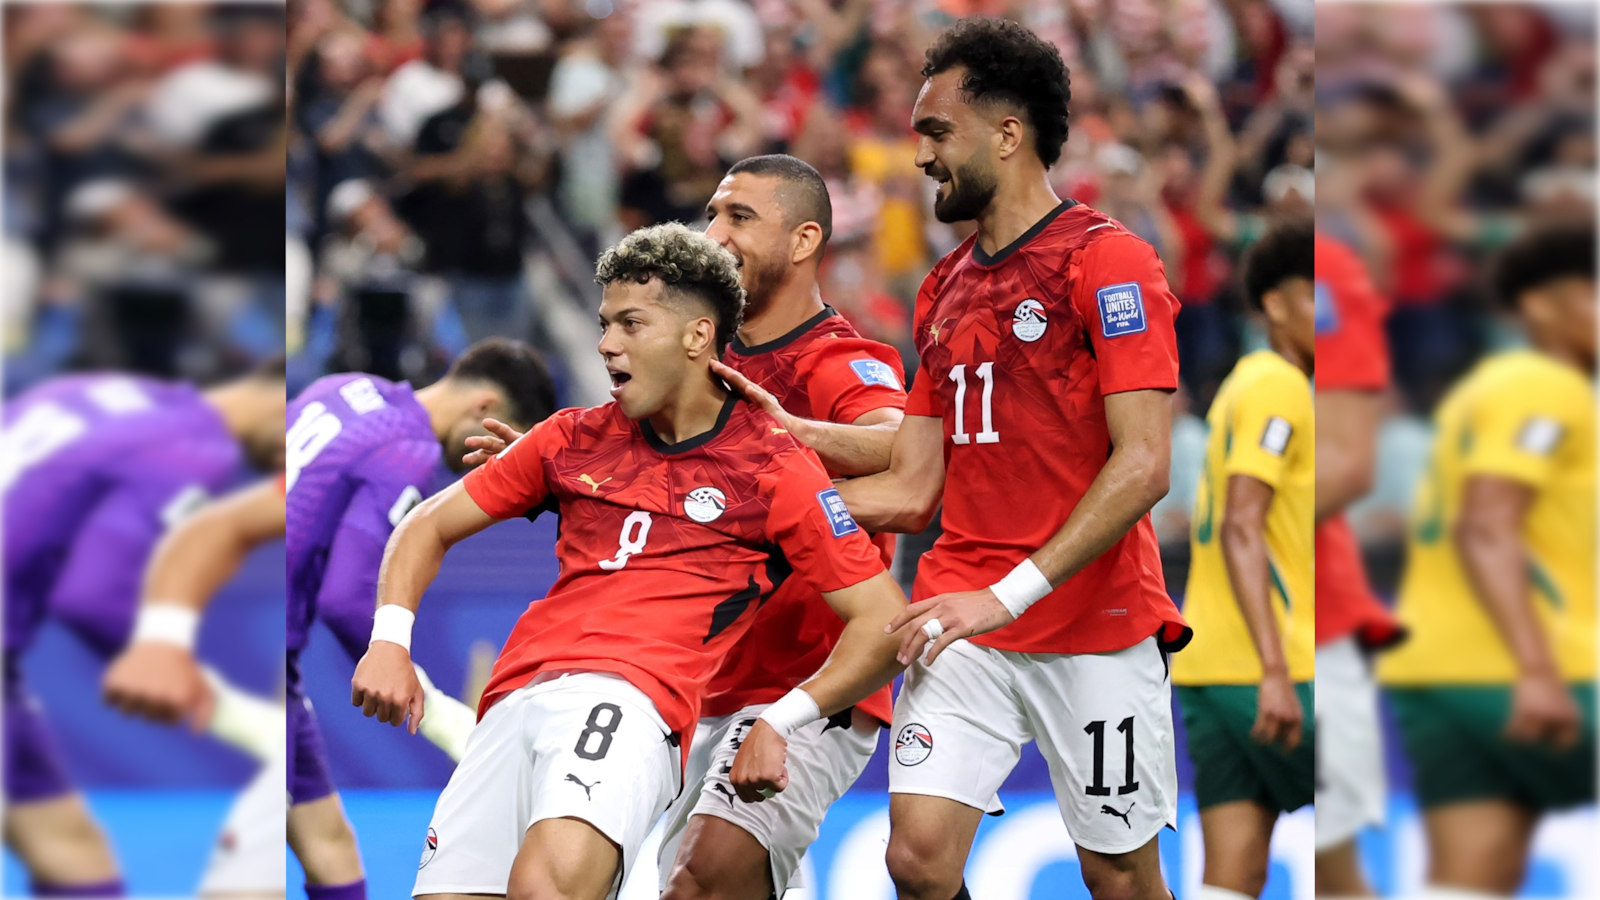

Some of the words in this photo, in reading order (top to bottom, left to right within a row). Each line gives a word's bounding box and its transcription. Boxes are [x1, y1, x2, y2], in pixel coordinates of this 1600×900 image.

[1103, 291, 1134, 303] FOOTBALL
[1105, 299, 1136, 314] UNITES
[1106, 313, 1118, 323] the
[1117, 309, 1139, 321] World
[948, 361, 1000, 445] 11
[574, 702, 623, 761] 8
[1083, 715, 1139, 797] 11
